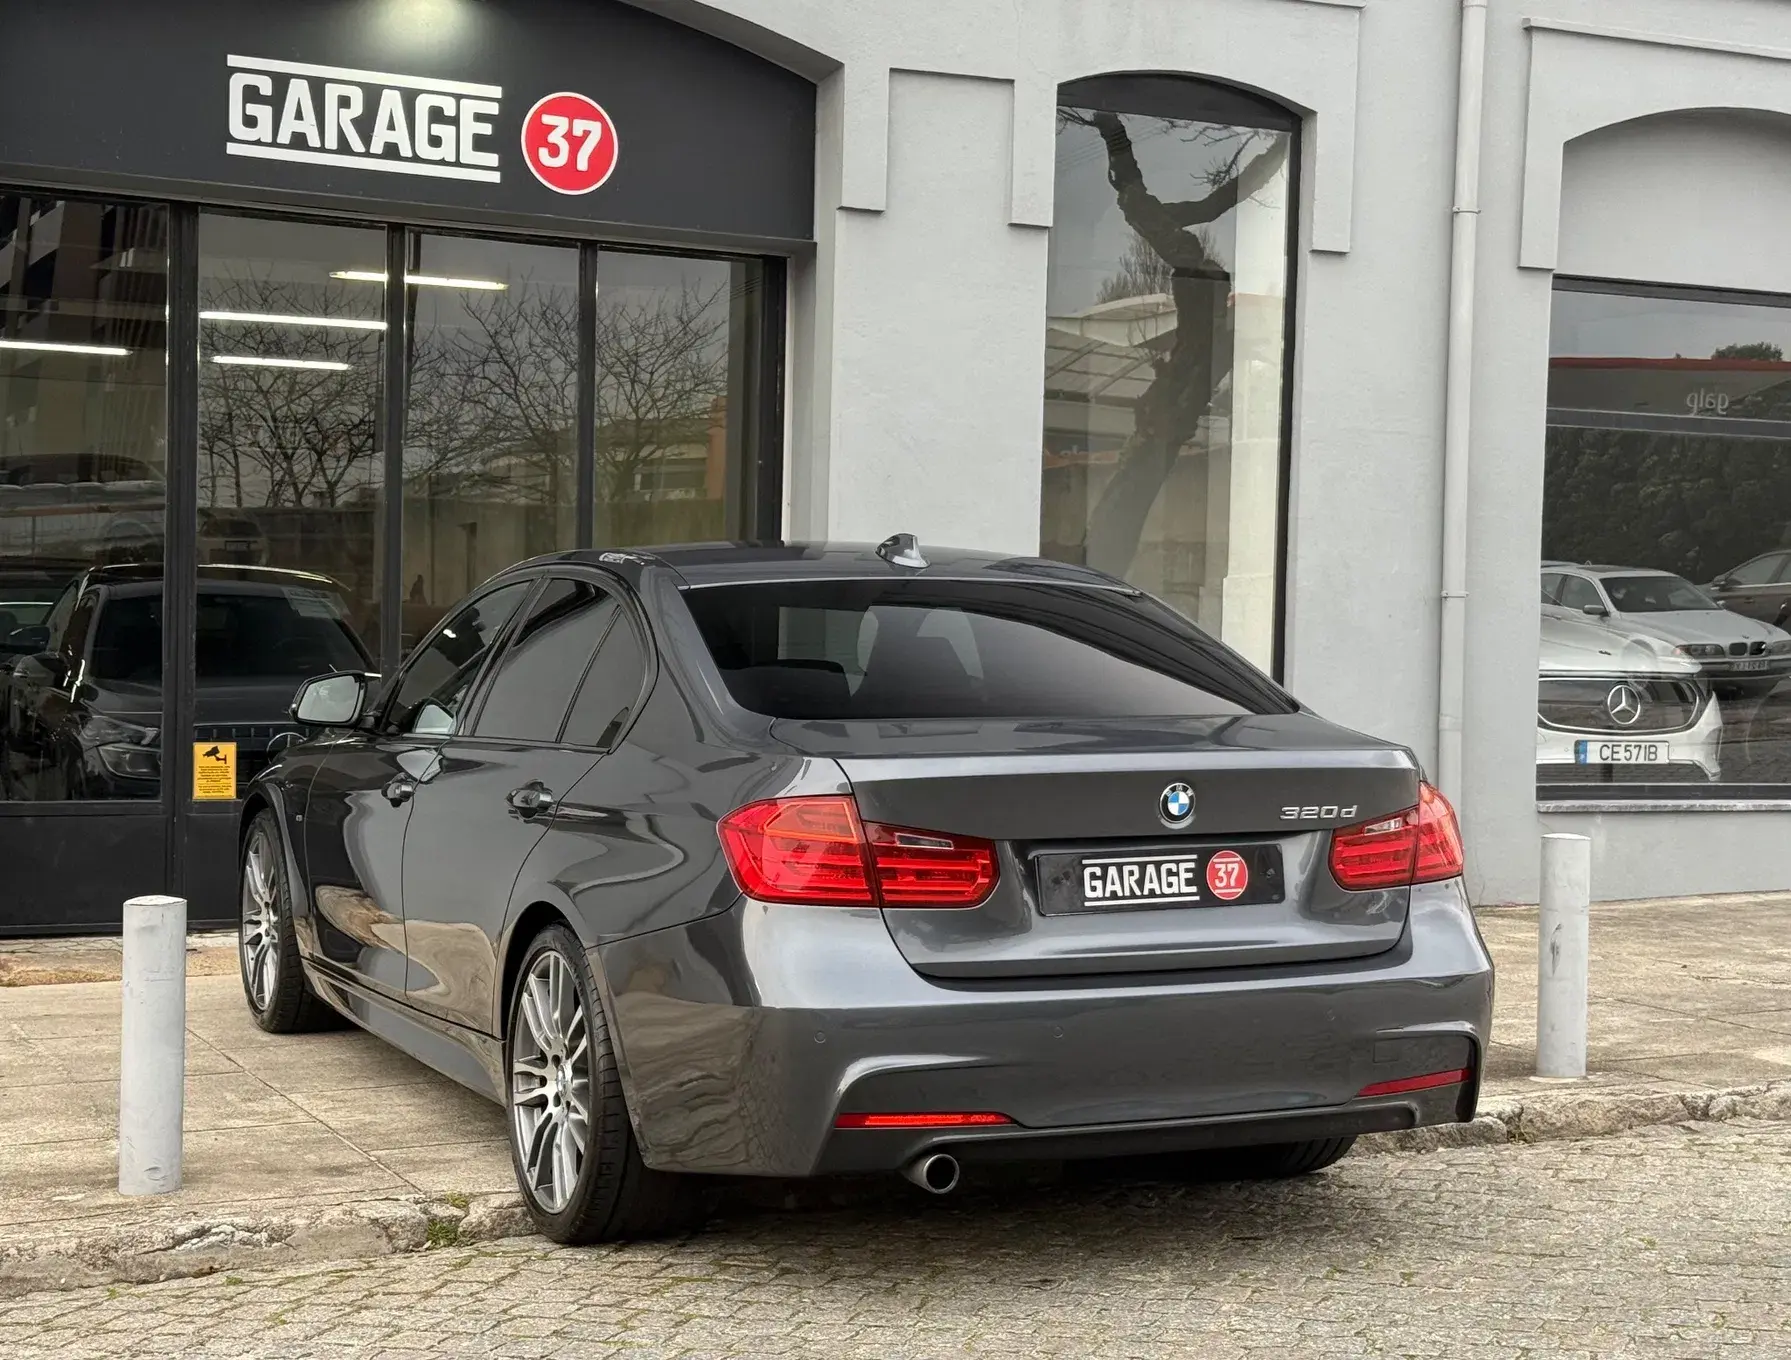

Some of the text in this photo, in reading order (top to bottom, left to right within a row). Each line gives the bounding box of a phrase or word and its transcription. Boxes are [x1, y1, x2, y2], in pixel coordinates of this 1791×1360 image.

[229, 72, 602, 172] GARAGE 37
[1280, 804, 1358, 820] 320d
[1083, 862, 1240, 898] GARAGE 37
